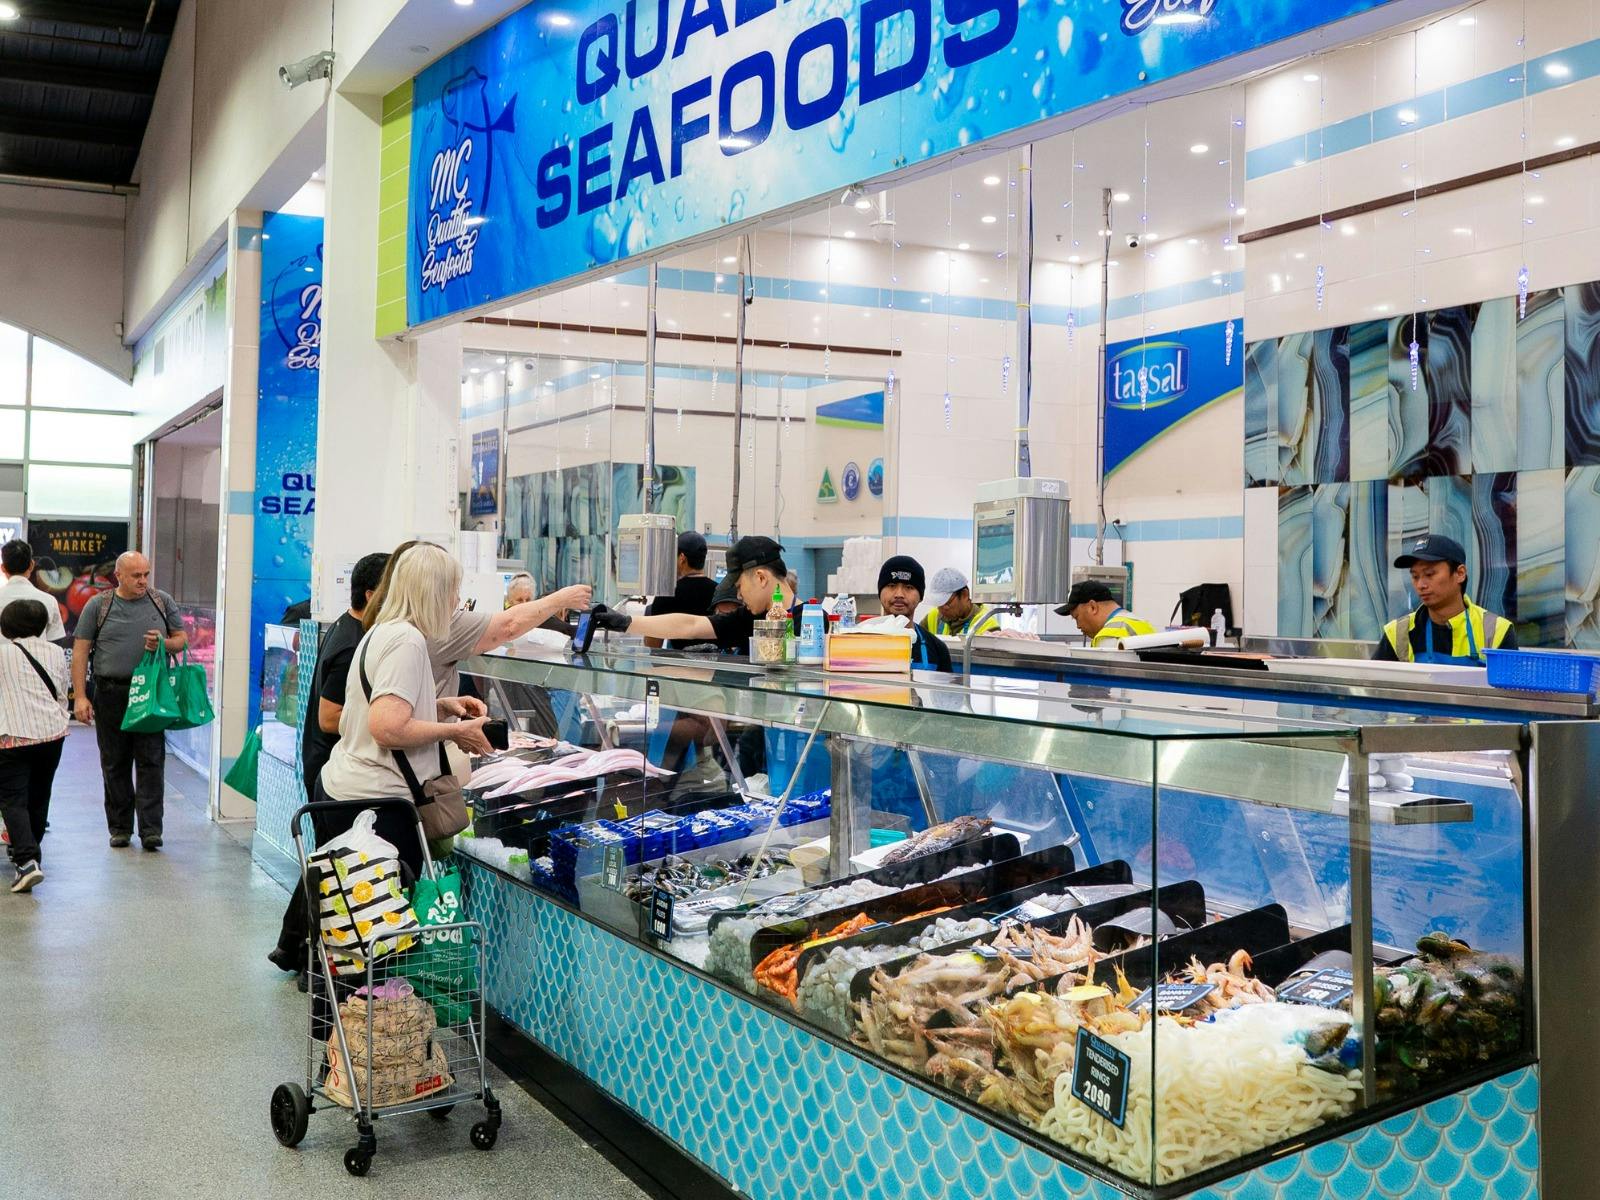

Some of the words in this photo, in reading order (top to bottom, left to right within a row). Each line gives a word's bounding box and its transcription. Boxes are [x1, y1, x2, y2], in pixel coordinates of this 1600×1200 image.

[537, 0, 1019, 229] SEAFOODS
[430, 138, 473, 211] MC
[428, 197, 473, 251] Quality
[421, 229, 479, 291] Seafoods
[48, 530, 107, 541] DANDENONG
[53, 539, 103, 553] MARKET
[1085, 1047, 1120, 1076] TENDERISED
[1090, 1066, 1111, 1087] RINGS
[1083, 1080, 1112, 1112] 2090
